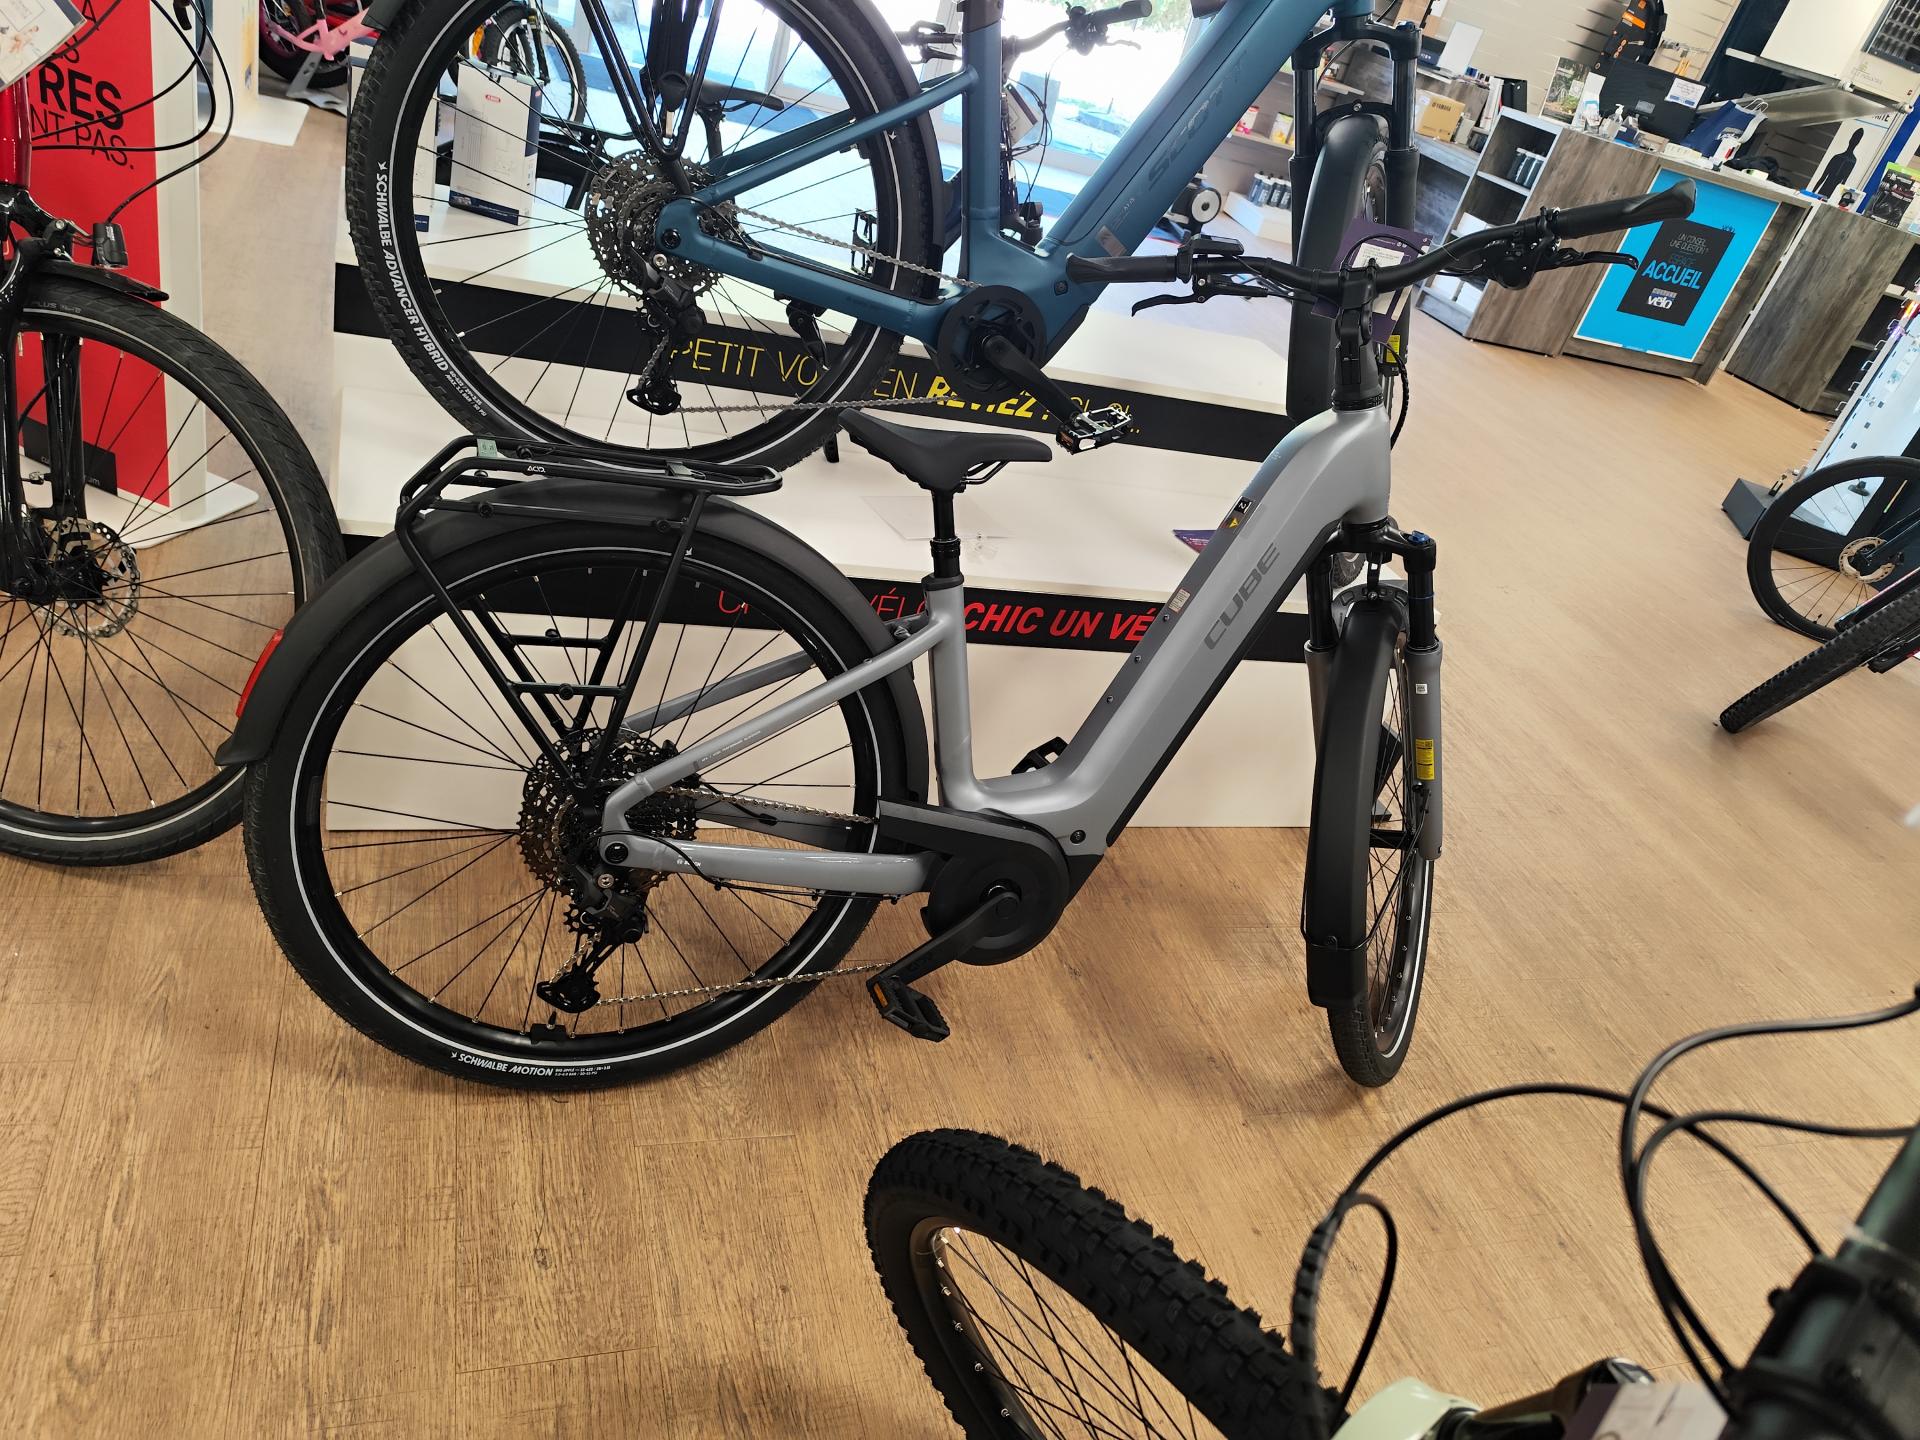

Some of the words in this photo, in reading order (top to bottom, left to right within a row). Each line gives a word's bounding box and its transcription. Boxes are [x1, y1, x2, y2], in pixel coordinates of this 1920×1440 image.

[27, 62, 124, 130] RES
[376, 173, 393, 247] SCHWALBE
[382, 249, 419, 325] ADVANCER
[1642, 259, 1703, 290] ACCUEIL
[413, 326, 449, 371] HYBRID
[964, 602, 1044, 634] CHIC
[1050, 608, 1104, 639] UN
[1204, 542, 1280, 650] CUBE
[458, 1053, 508, 1072] SCHWALBE
[508, 1064, 554, 1076] MOTION
